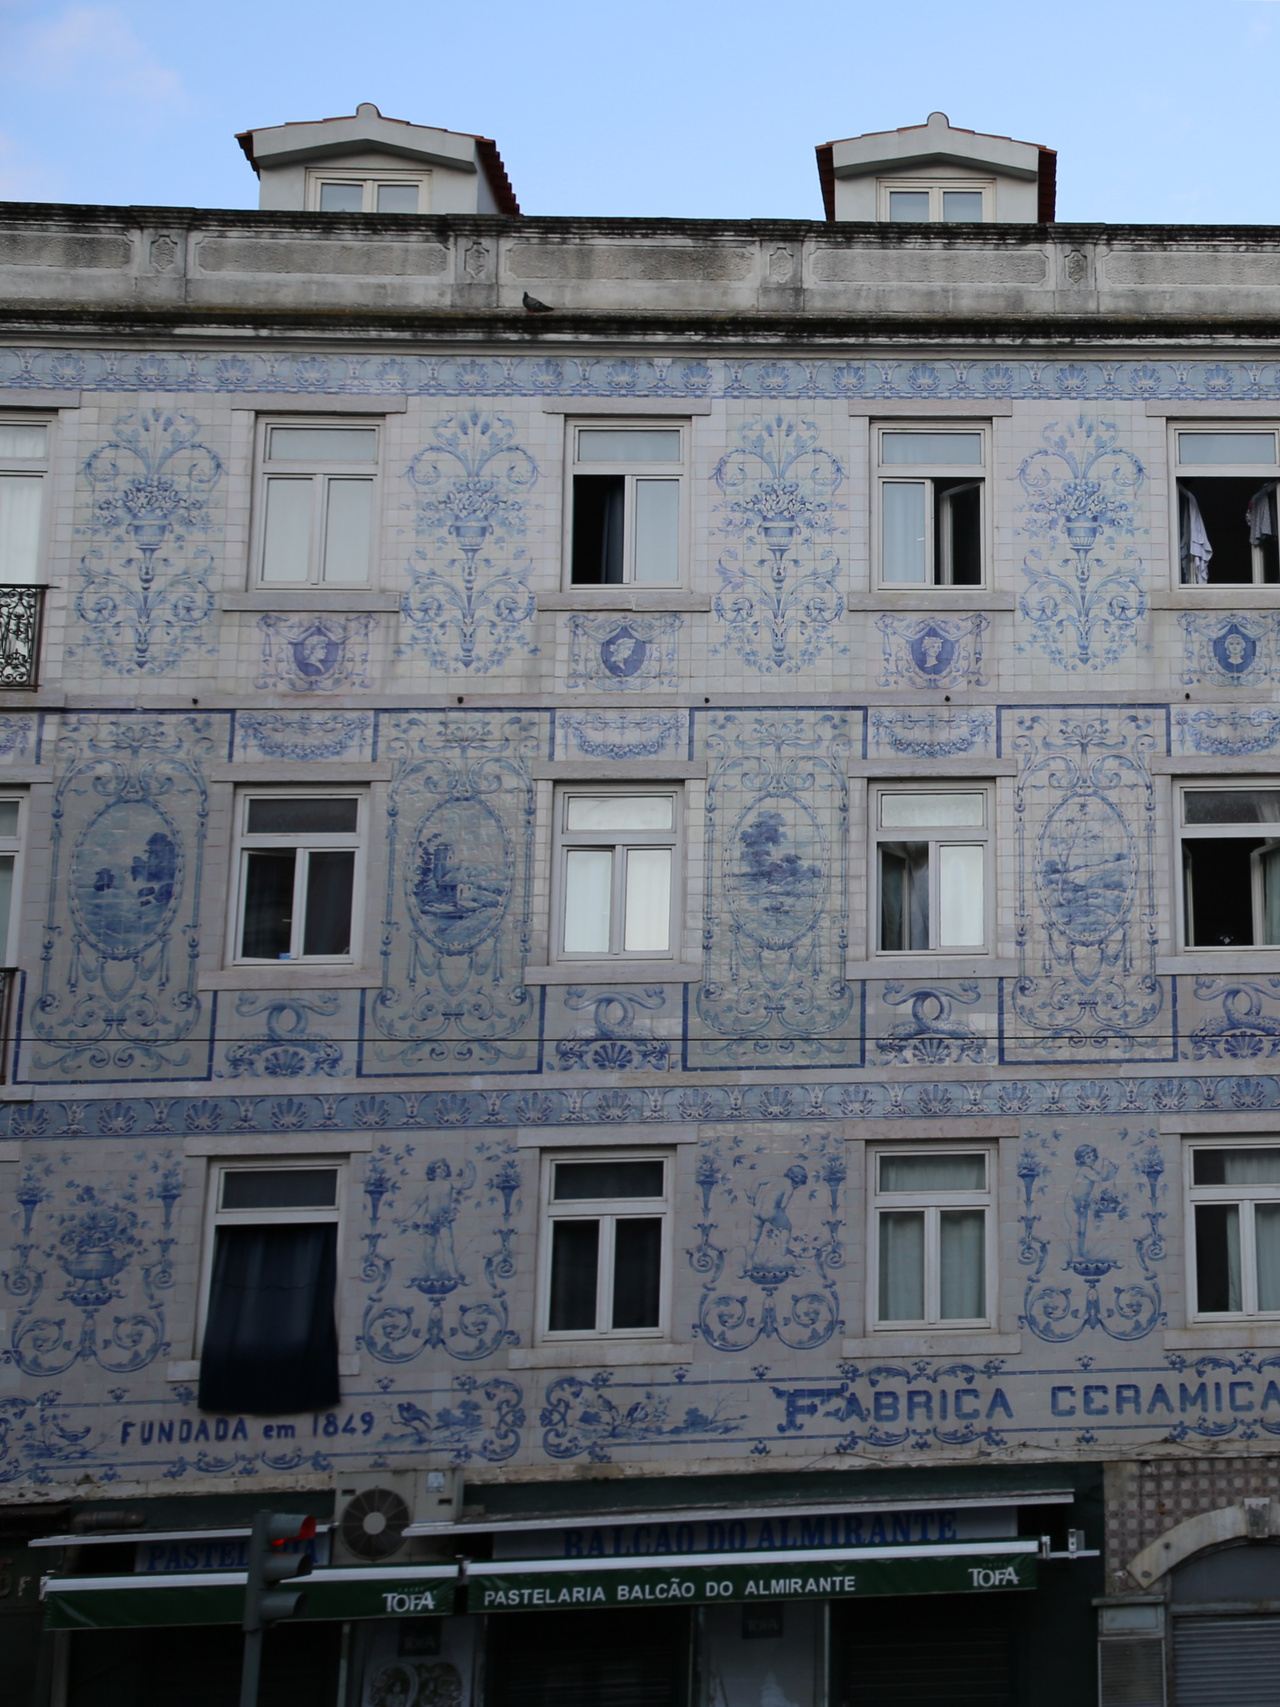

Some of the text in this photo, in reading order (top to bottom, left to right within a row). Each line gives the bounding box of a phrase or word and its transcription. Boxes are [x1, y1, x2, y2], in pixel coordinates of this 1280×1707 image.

[768, 1382, 1013, 1433] FABRICA
[120, 1411, 375, 1446] FUNDADA em 1849
[705, 1520, 747, 1550] DO
[757, 1510, 957, 1549] ALMIRANTE
[484, 1576, 856, 1606] PASTELARIA BALCÃO DO ALMIRANTE
[968, 1566, 1020, 1588] TOFA
[381, 1590, 436, 1613] TOFA
